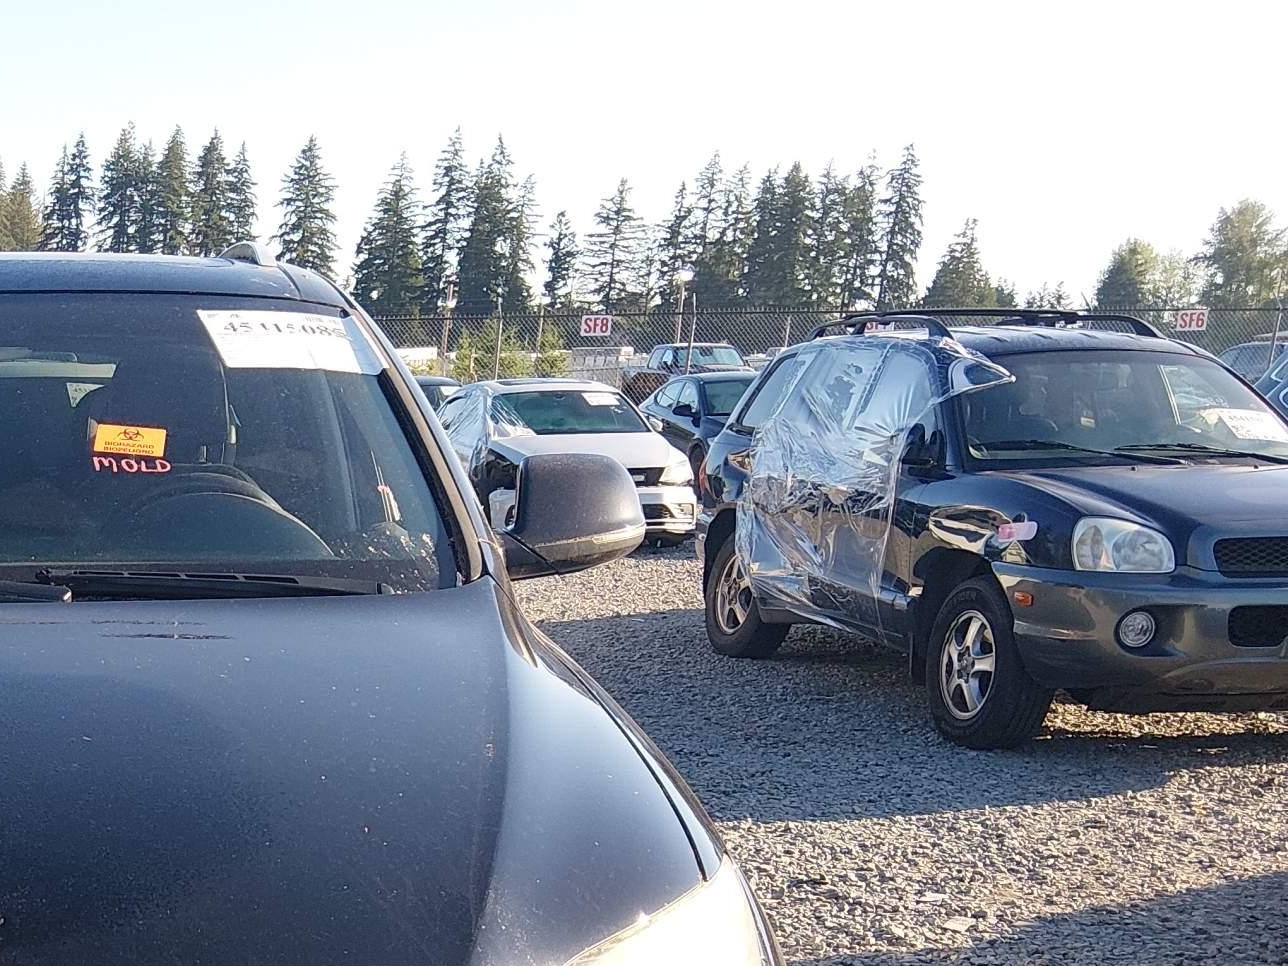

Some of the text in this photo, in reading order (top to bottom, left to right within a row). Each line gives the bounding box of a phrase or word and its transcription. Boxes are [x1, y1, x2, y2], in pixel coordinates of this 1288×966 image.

[584, 317, 609, 334] SF8
[1179, 312, 1205, 329] SF6
[104, 440, 155, 449] BIOHAZARD
[92, 456, 171, 473] MOLD
